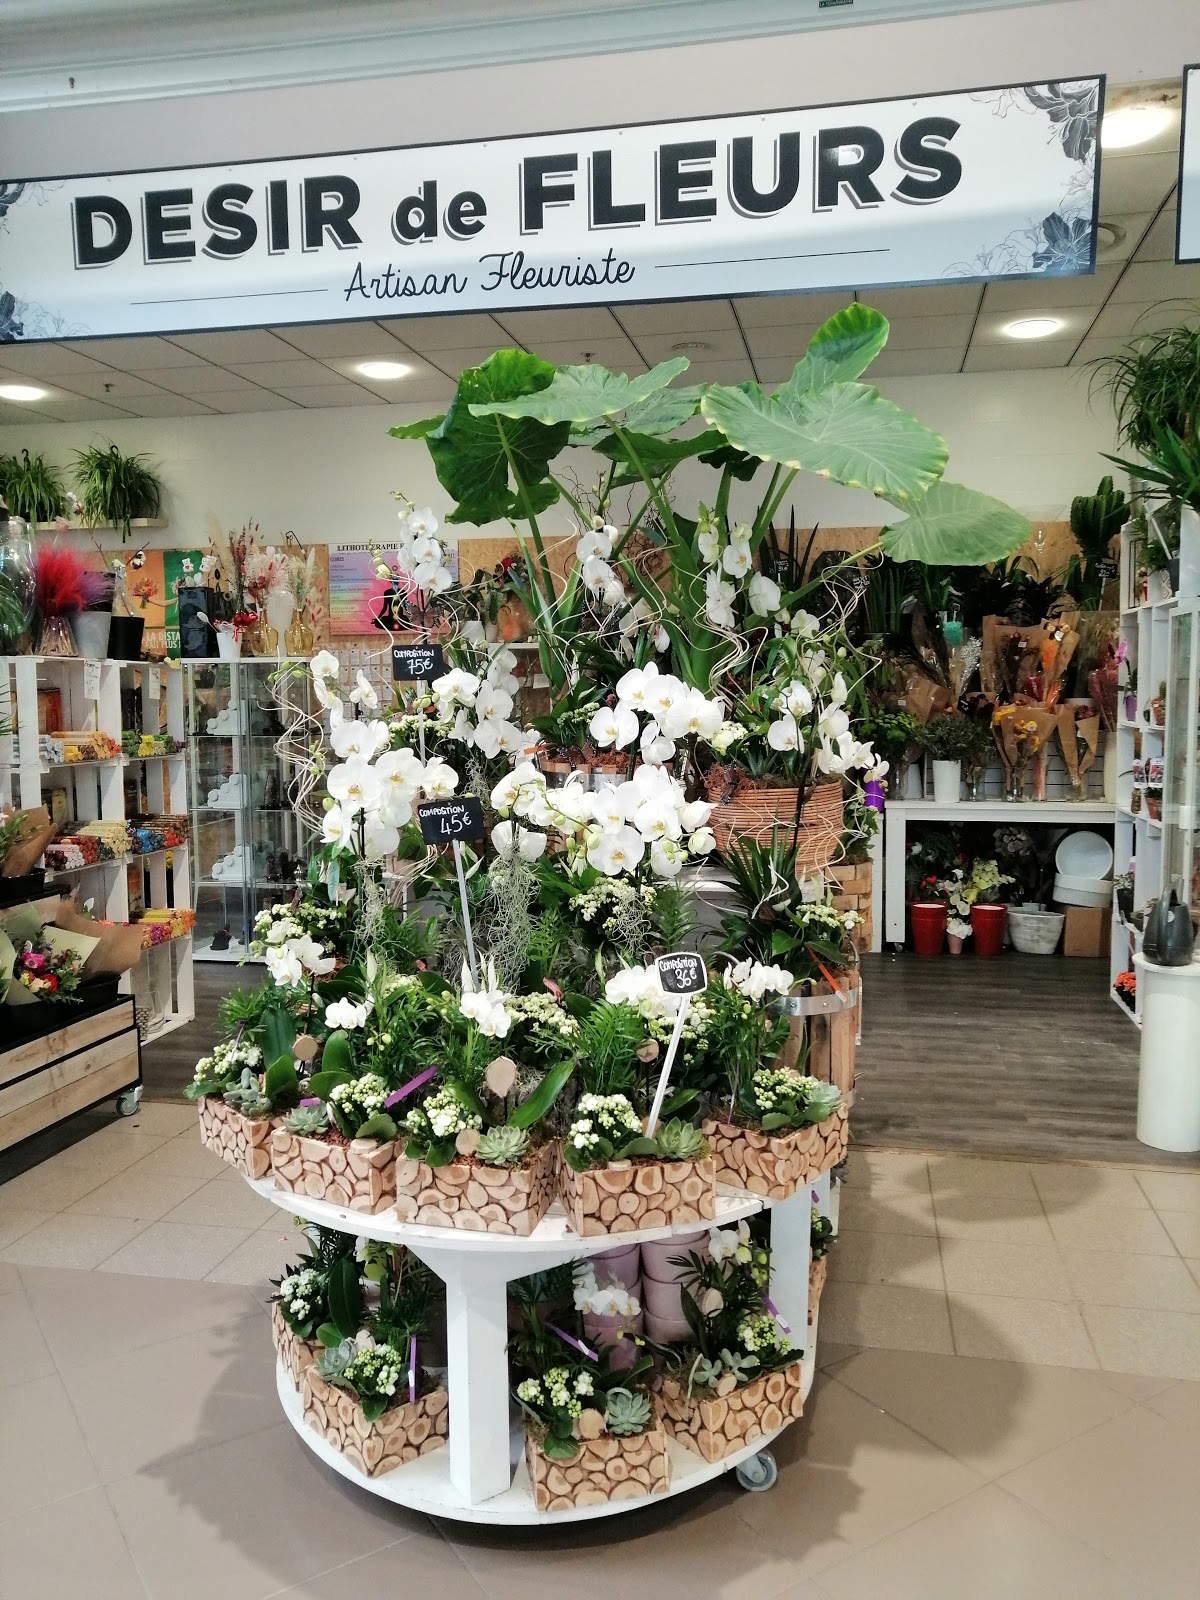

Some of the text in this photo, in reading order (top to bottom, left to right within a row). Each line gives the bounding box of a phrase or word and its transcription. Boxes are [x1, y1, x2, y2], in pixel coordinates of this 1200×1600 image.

[71, 116, 963, 270] DESIR de FLEURS
[344, 247, 636, 302] Artisan Fleuriste
[146, 631, 180, 641] LA DISTA
[161, 640, 177, 649] PLUS
[406, 658, 434, 675] 75€
[440, 812, 472, 835] 45€
